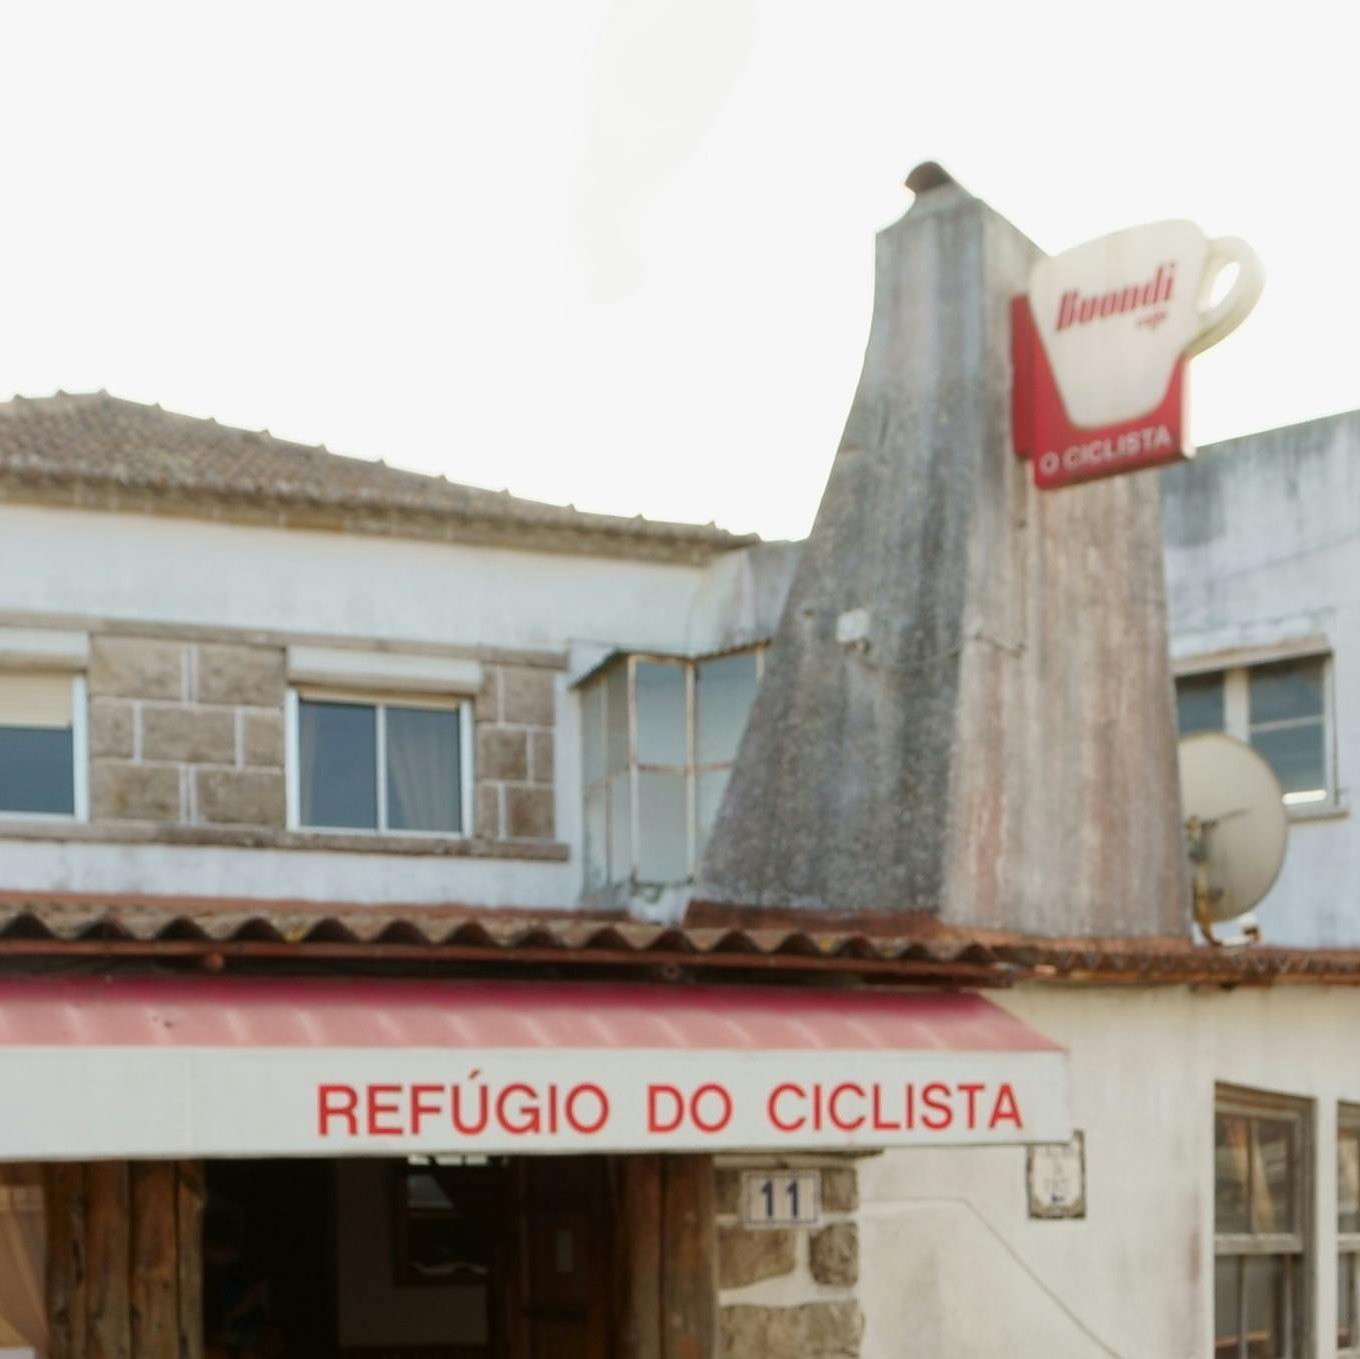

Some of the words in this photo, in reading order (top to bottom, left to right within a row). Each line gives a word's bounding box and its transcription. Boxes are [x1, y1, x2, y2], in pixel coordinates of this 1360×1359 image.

[1039, 452, 1060, 476] O
[1062, 424, 1173, 471] CICLISTA
[316, 1070, 611, 1136] REFÚGIO
[646, 1082, 734, 1135] DO
[765, 1081, 1024, 1133] CICLISTA
[759, 1178, 803, 1219] 11
